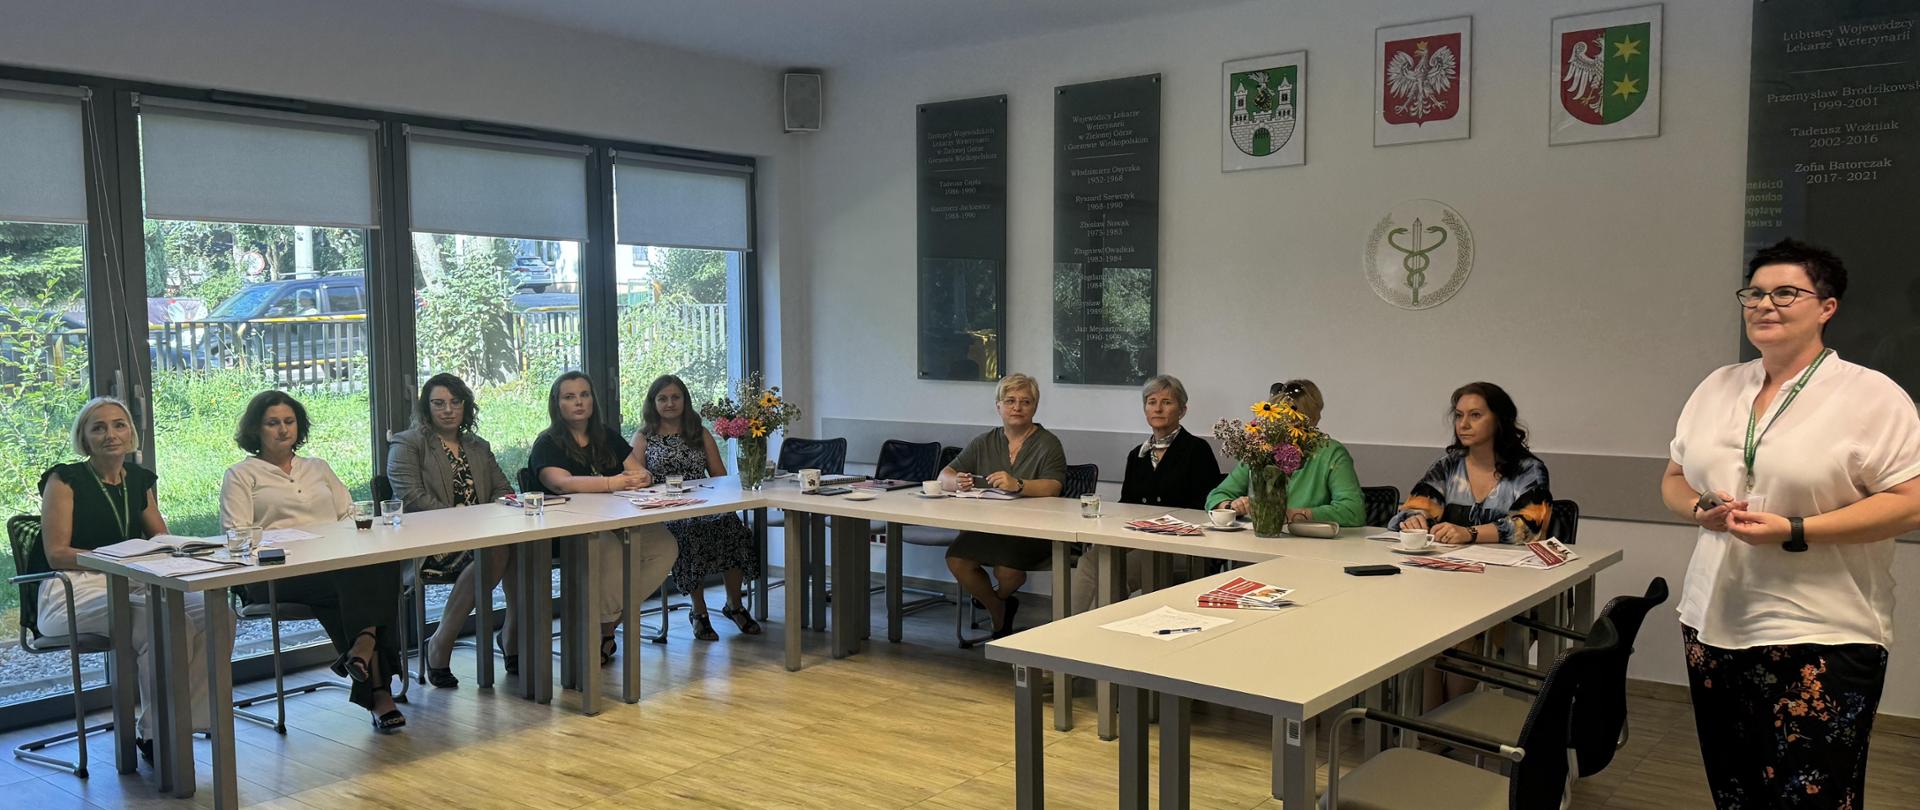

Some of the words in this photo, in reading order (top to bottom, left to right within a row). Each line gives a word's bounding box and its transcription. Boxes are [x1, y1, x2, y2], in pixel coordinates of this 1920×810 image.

[1783, 28, 1834, 42] Lubuscy
[1786, 41, 1832, 53] Lekarze
[1837, 31, 1911, 48] Weterynarii
[1767, 88, 1838, 103] Przemysław
[1813, 97, 1878, 112] 1999-2001
[1791, 124, 1841, 137] Tadeusz
[1810, 134, 1878, 148] 2002-2016
[1794, 161, 1825, 173] Zofia
[1829, 157, 1892, 170] Batorczak
[1847, 171, 1877, 181] 2021
